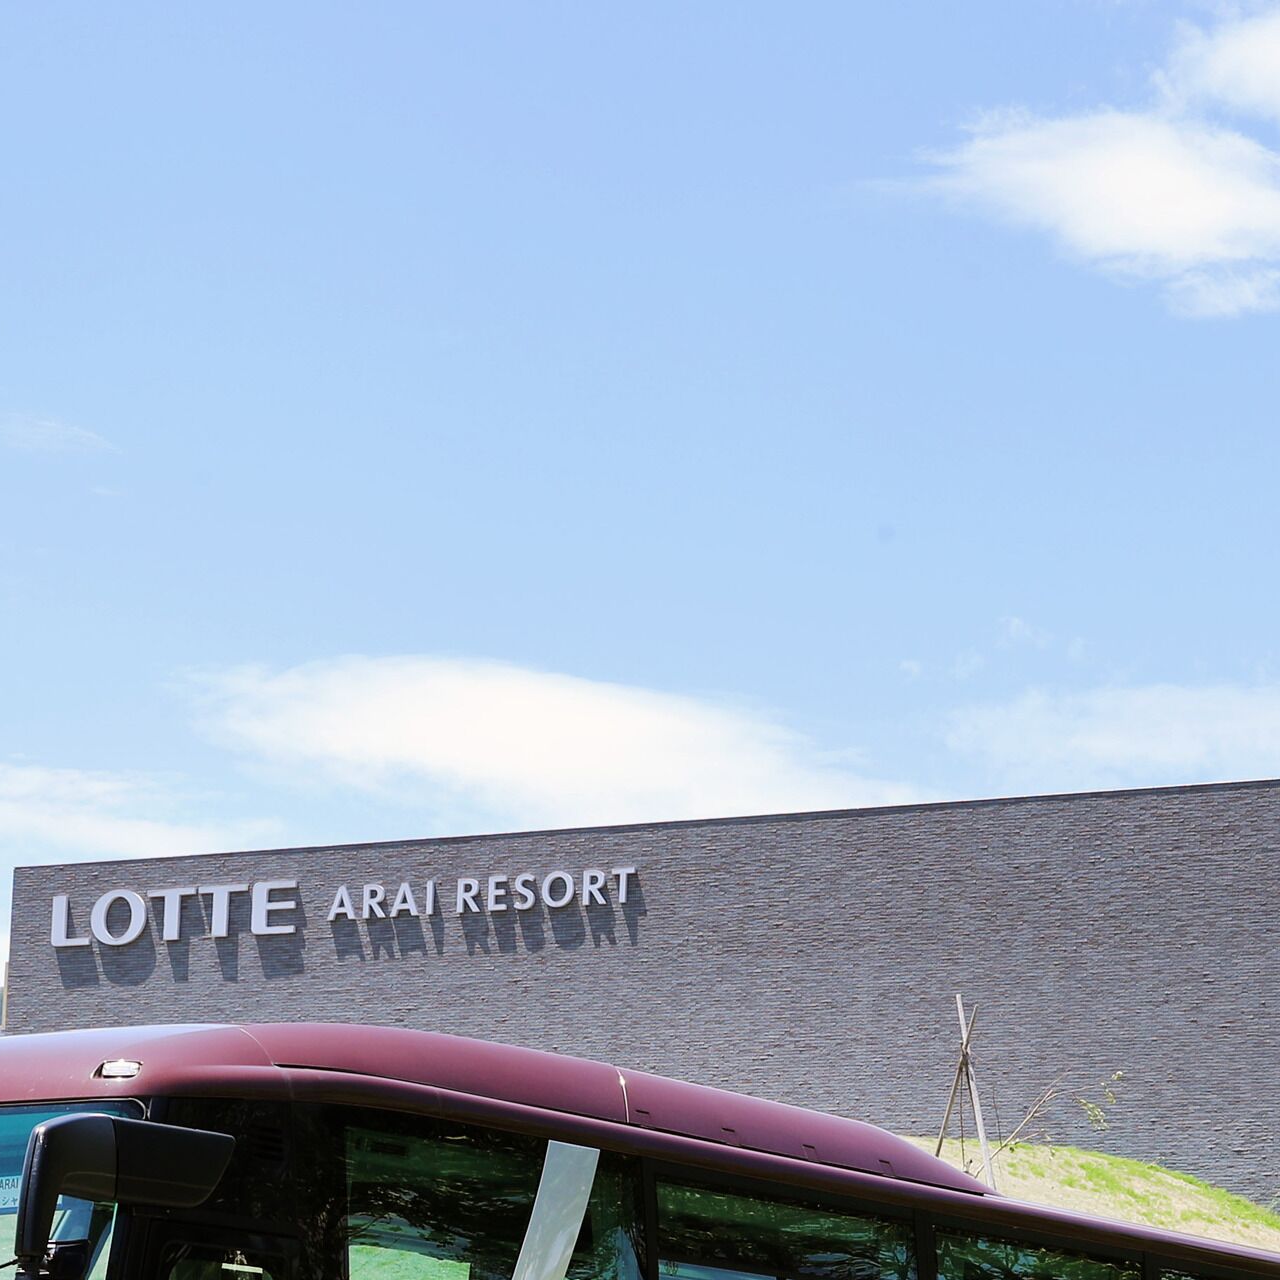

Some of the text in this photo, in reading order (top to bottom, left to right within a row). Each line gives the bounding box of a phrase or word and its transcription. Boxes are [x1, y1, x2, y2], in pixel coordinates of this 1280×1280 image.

[50, 866, 638, 948] LOTTE ARAI RESORT
